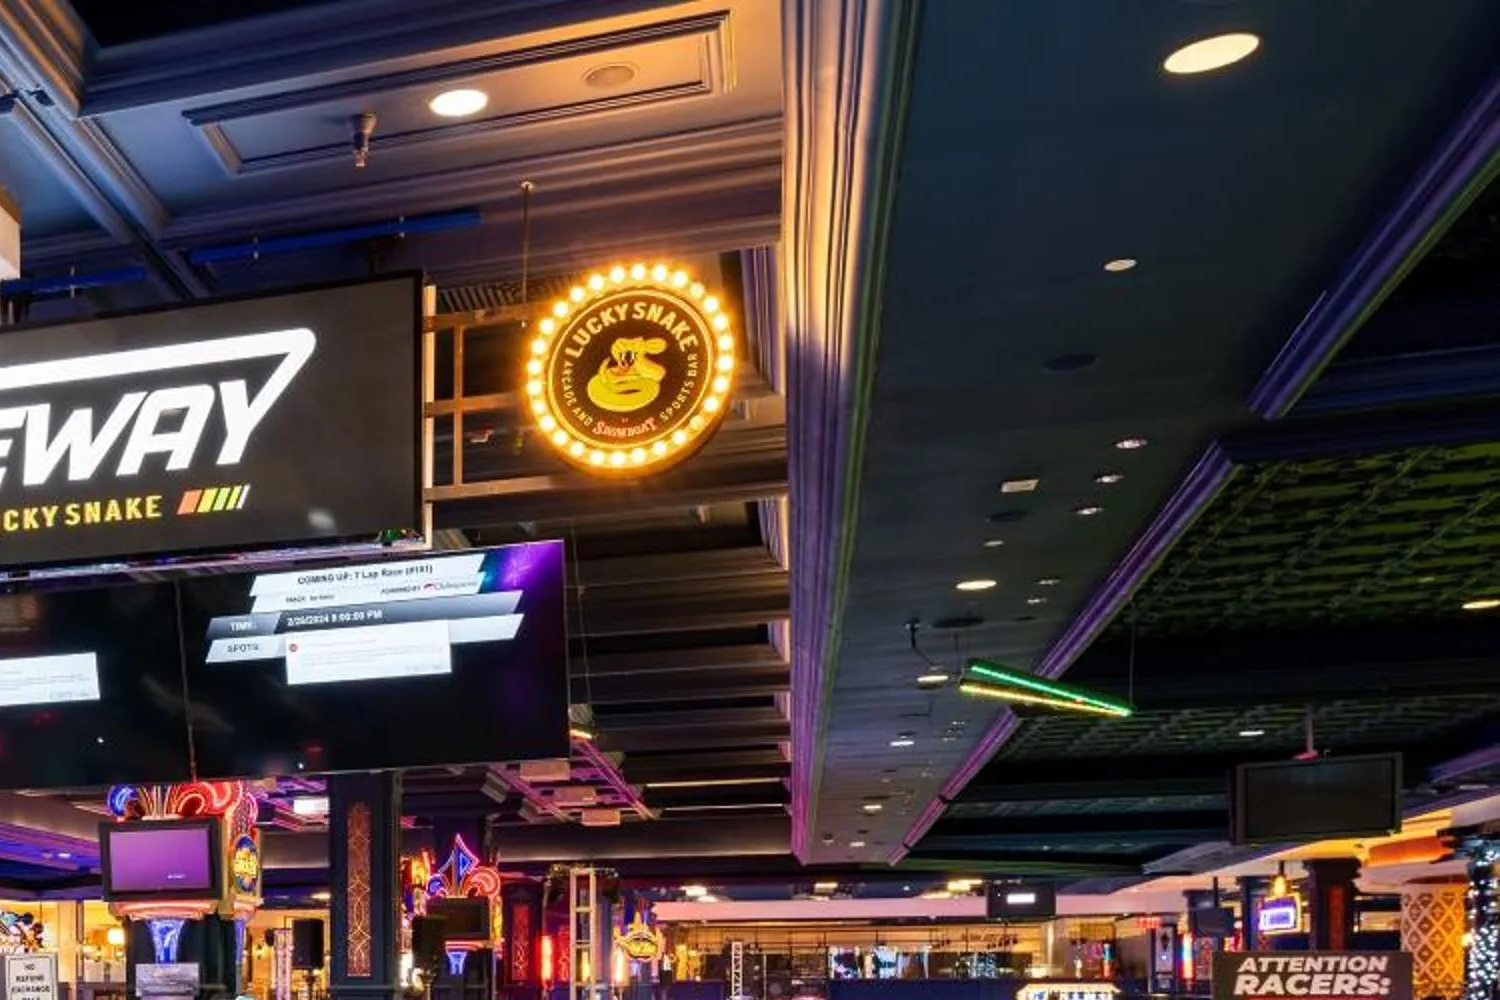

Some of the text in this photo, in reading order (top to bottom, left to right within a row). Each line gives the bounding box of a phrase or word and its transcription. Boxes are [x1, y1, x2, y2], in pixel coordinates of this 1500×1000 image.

[565, 302, 699, 358] LUCKY SNAKE
[561, 361, 593, 427] ARCADE AND
[659, 353, 698, 422] SPORTS BAR
[66, 495, 162, 526] SNAKE
[297, 575, 334, 585] COMING
[367, 609, 383, 620] PM
[1237, 956, 1388, 973] ATTENTION
[1233, 974, 1392, 996] RACERS:
